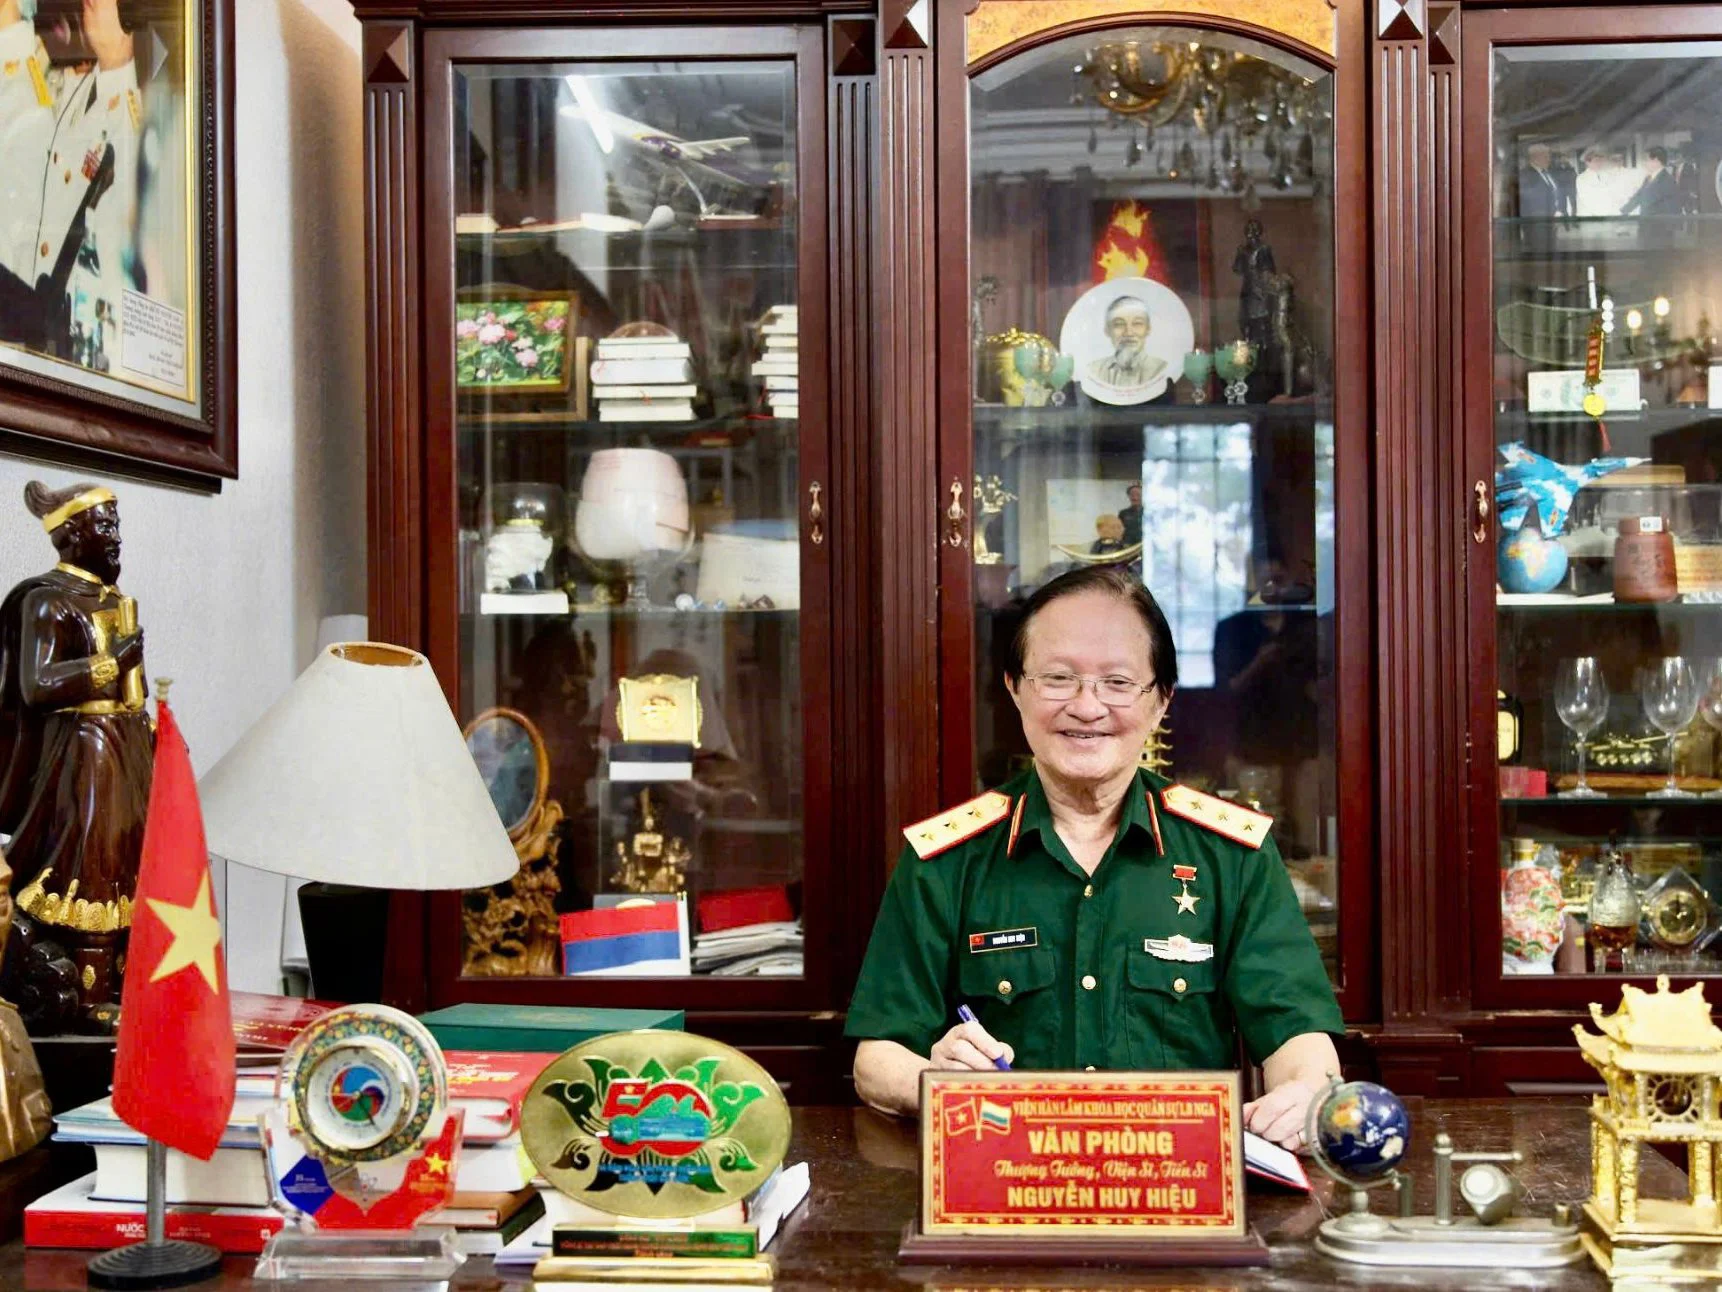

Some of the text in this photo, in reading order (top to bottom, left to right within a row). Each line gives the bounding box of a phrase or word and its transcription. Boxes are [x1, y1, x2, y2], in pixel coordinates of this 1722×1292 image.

[1012, 1097, 1037, 1117] VIỆN
[1061, 1097, 1083, 1116] LÂM
[1084, 1100, 1112, 1116] KHOA
[1114, 1101, 1136, 1118] HỌC
[1137, 1098, 1165, 1118] QUÂN
[1194, 1102, 1216, 1116] NGA
[1028, 1125, 1173, 1155] VĂN PHÒNG
[994, 1159, 1048, 1180] Thượng
[1103, 1160, 1137, 1181] Viện
[1160, 1160, 1190, 1179] Tiến
[1007, 1179, 1197, 1212] NGUYỄN HUY HIỆU
